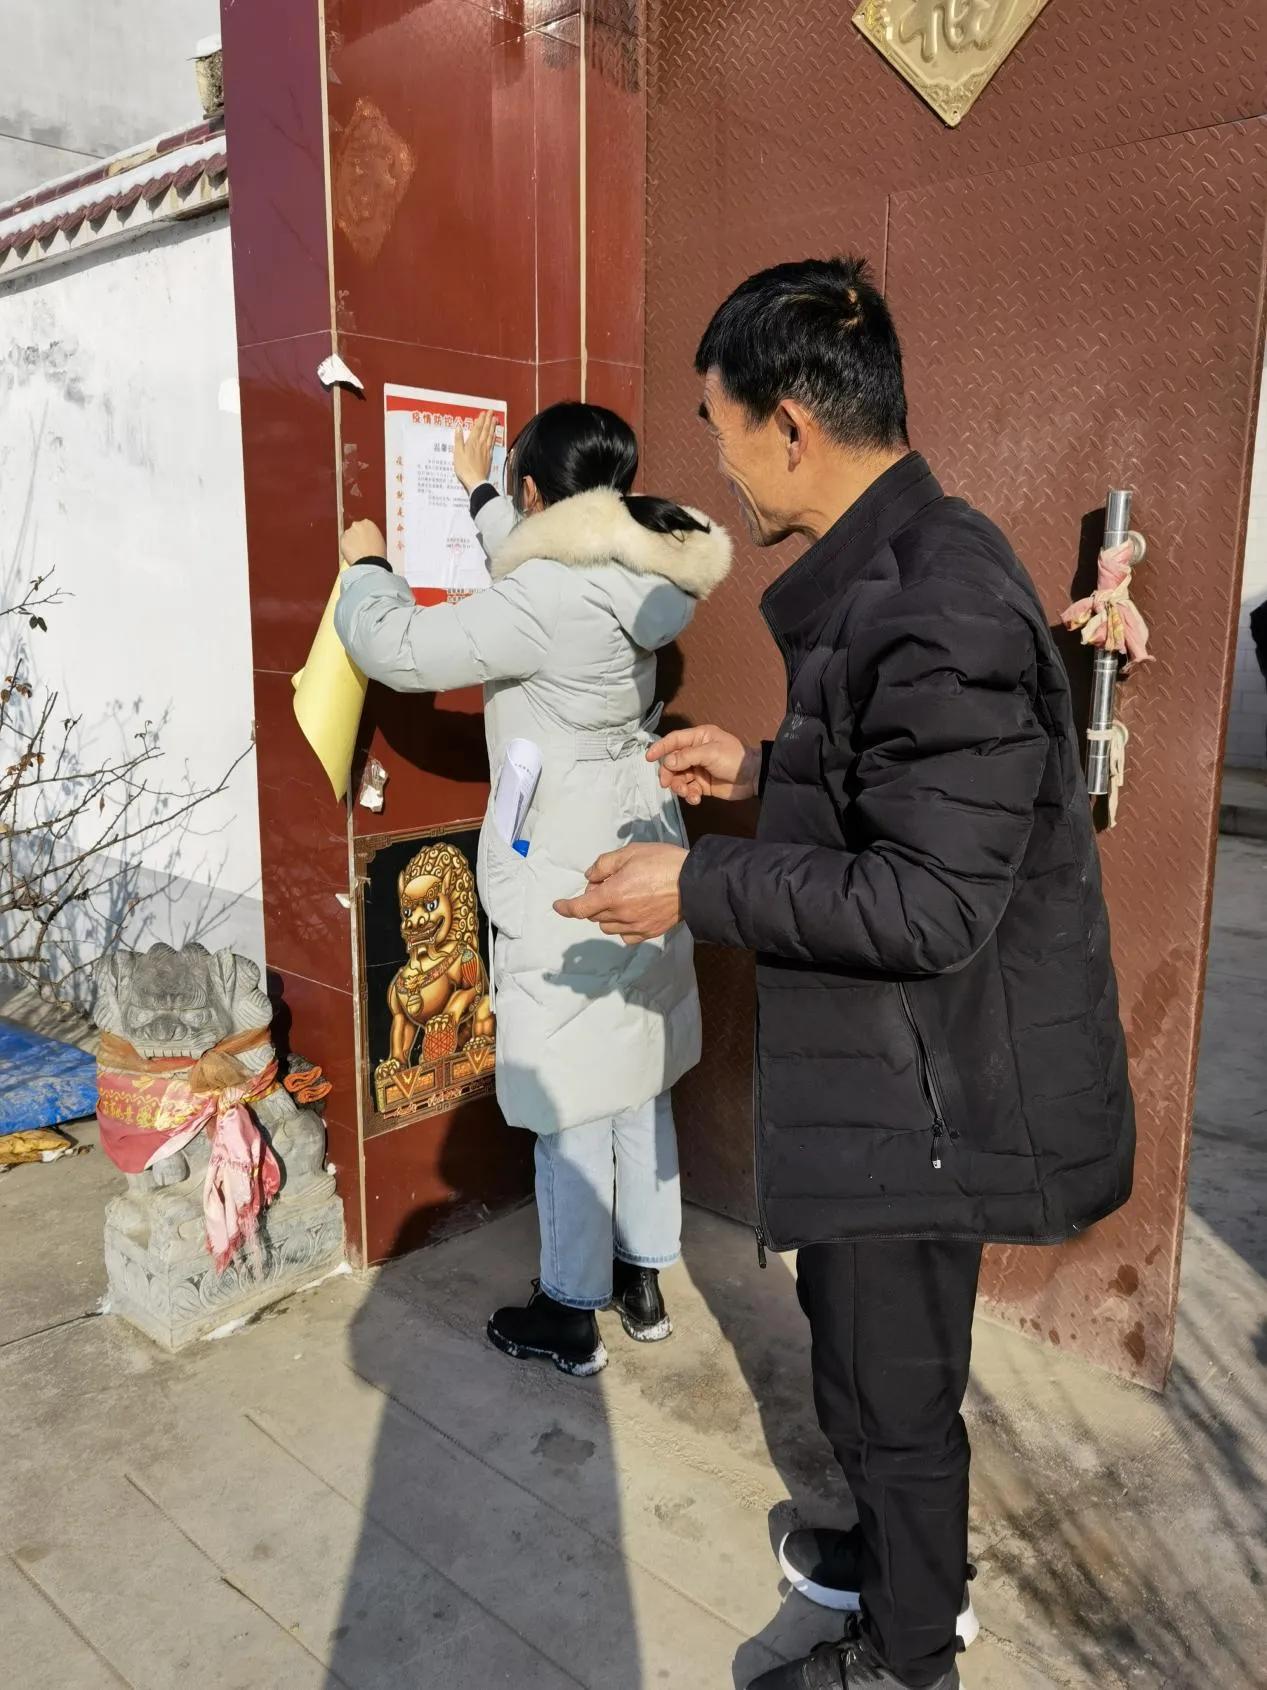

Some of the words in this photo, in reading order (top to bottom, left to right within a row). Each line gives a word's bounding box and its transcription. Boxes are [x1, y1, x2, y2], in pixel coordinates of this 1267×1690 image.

[411, 411, 475, 430] 疫情防控公示
